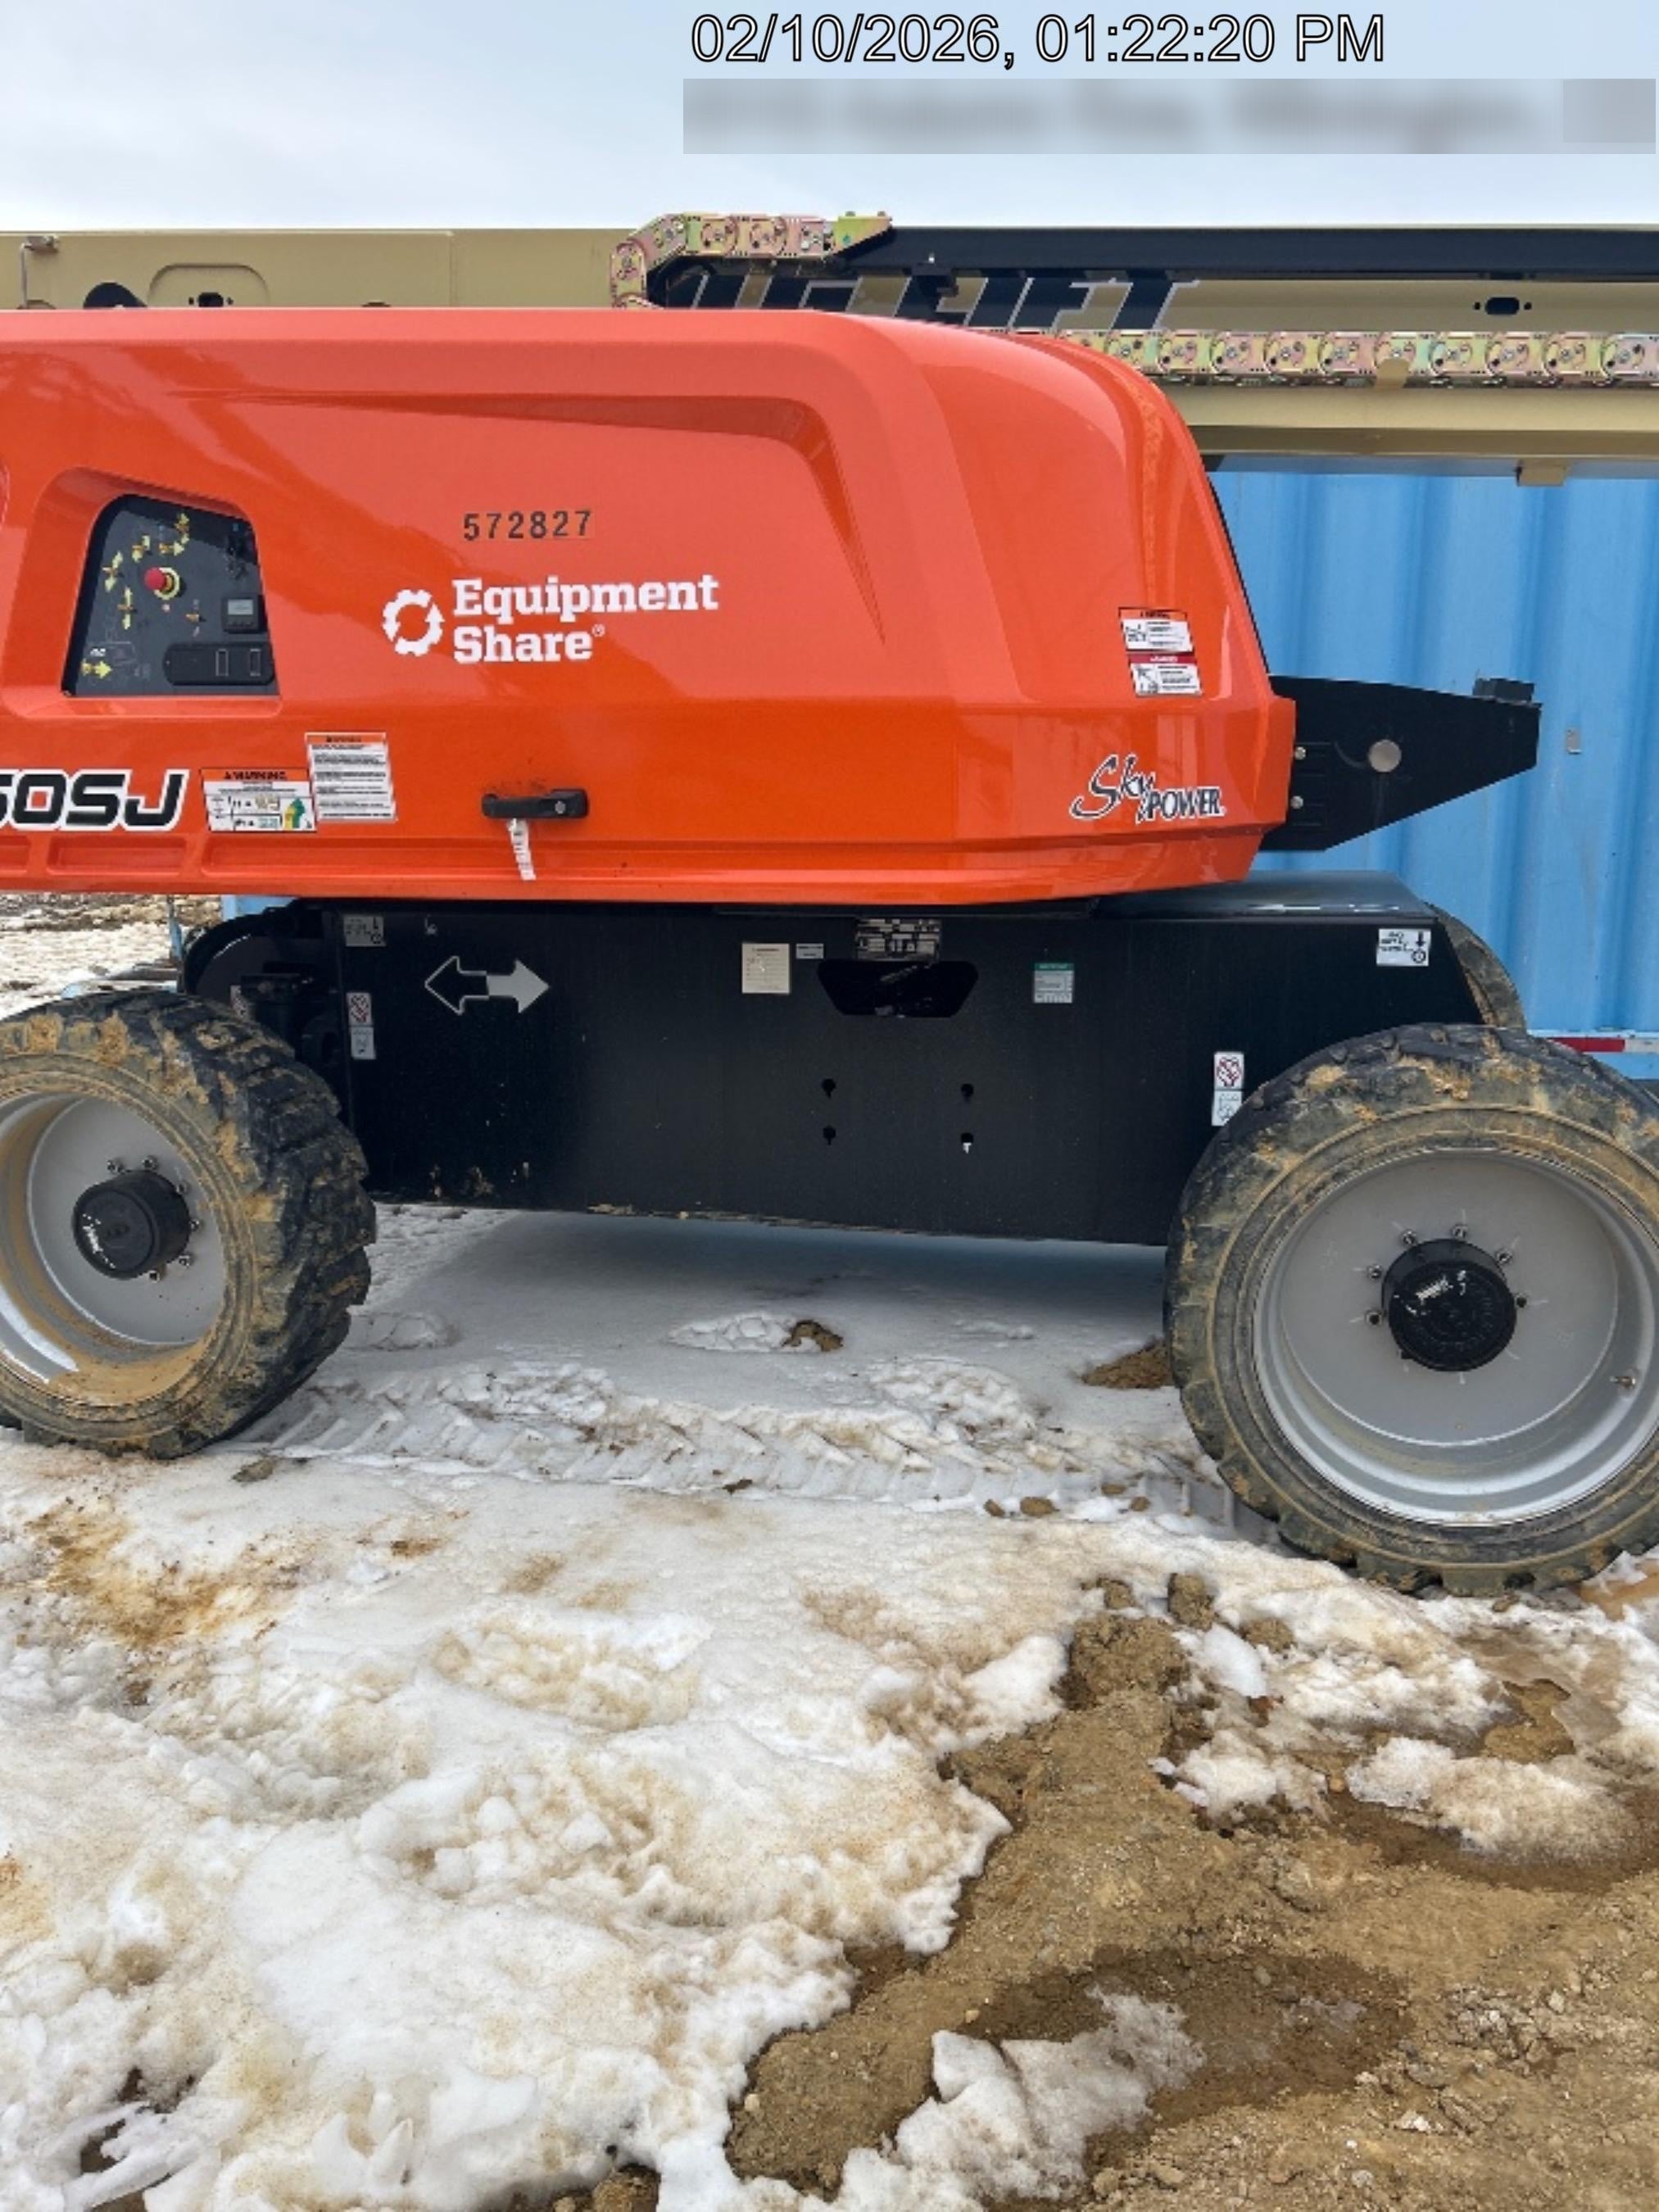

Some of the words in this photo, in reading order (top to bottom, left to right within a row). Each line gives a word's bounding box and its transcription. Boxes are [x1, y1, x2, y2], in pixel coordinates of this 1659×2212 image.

[463, 510, 592, 541] 572827
[452, 574, 719, 624] Equipment
[0, 768, 190, 832] 0SJ
[1144, 786, 1222, 821] POWER
